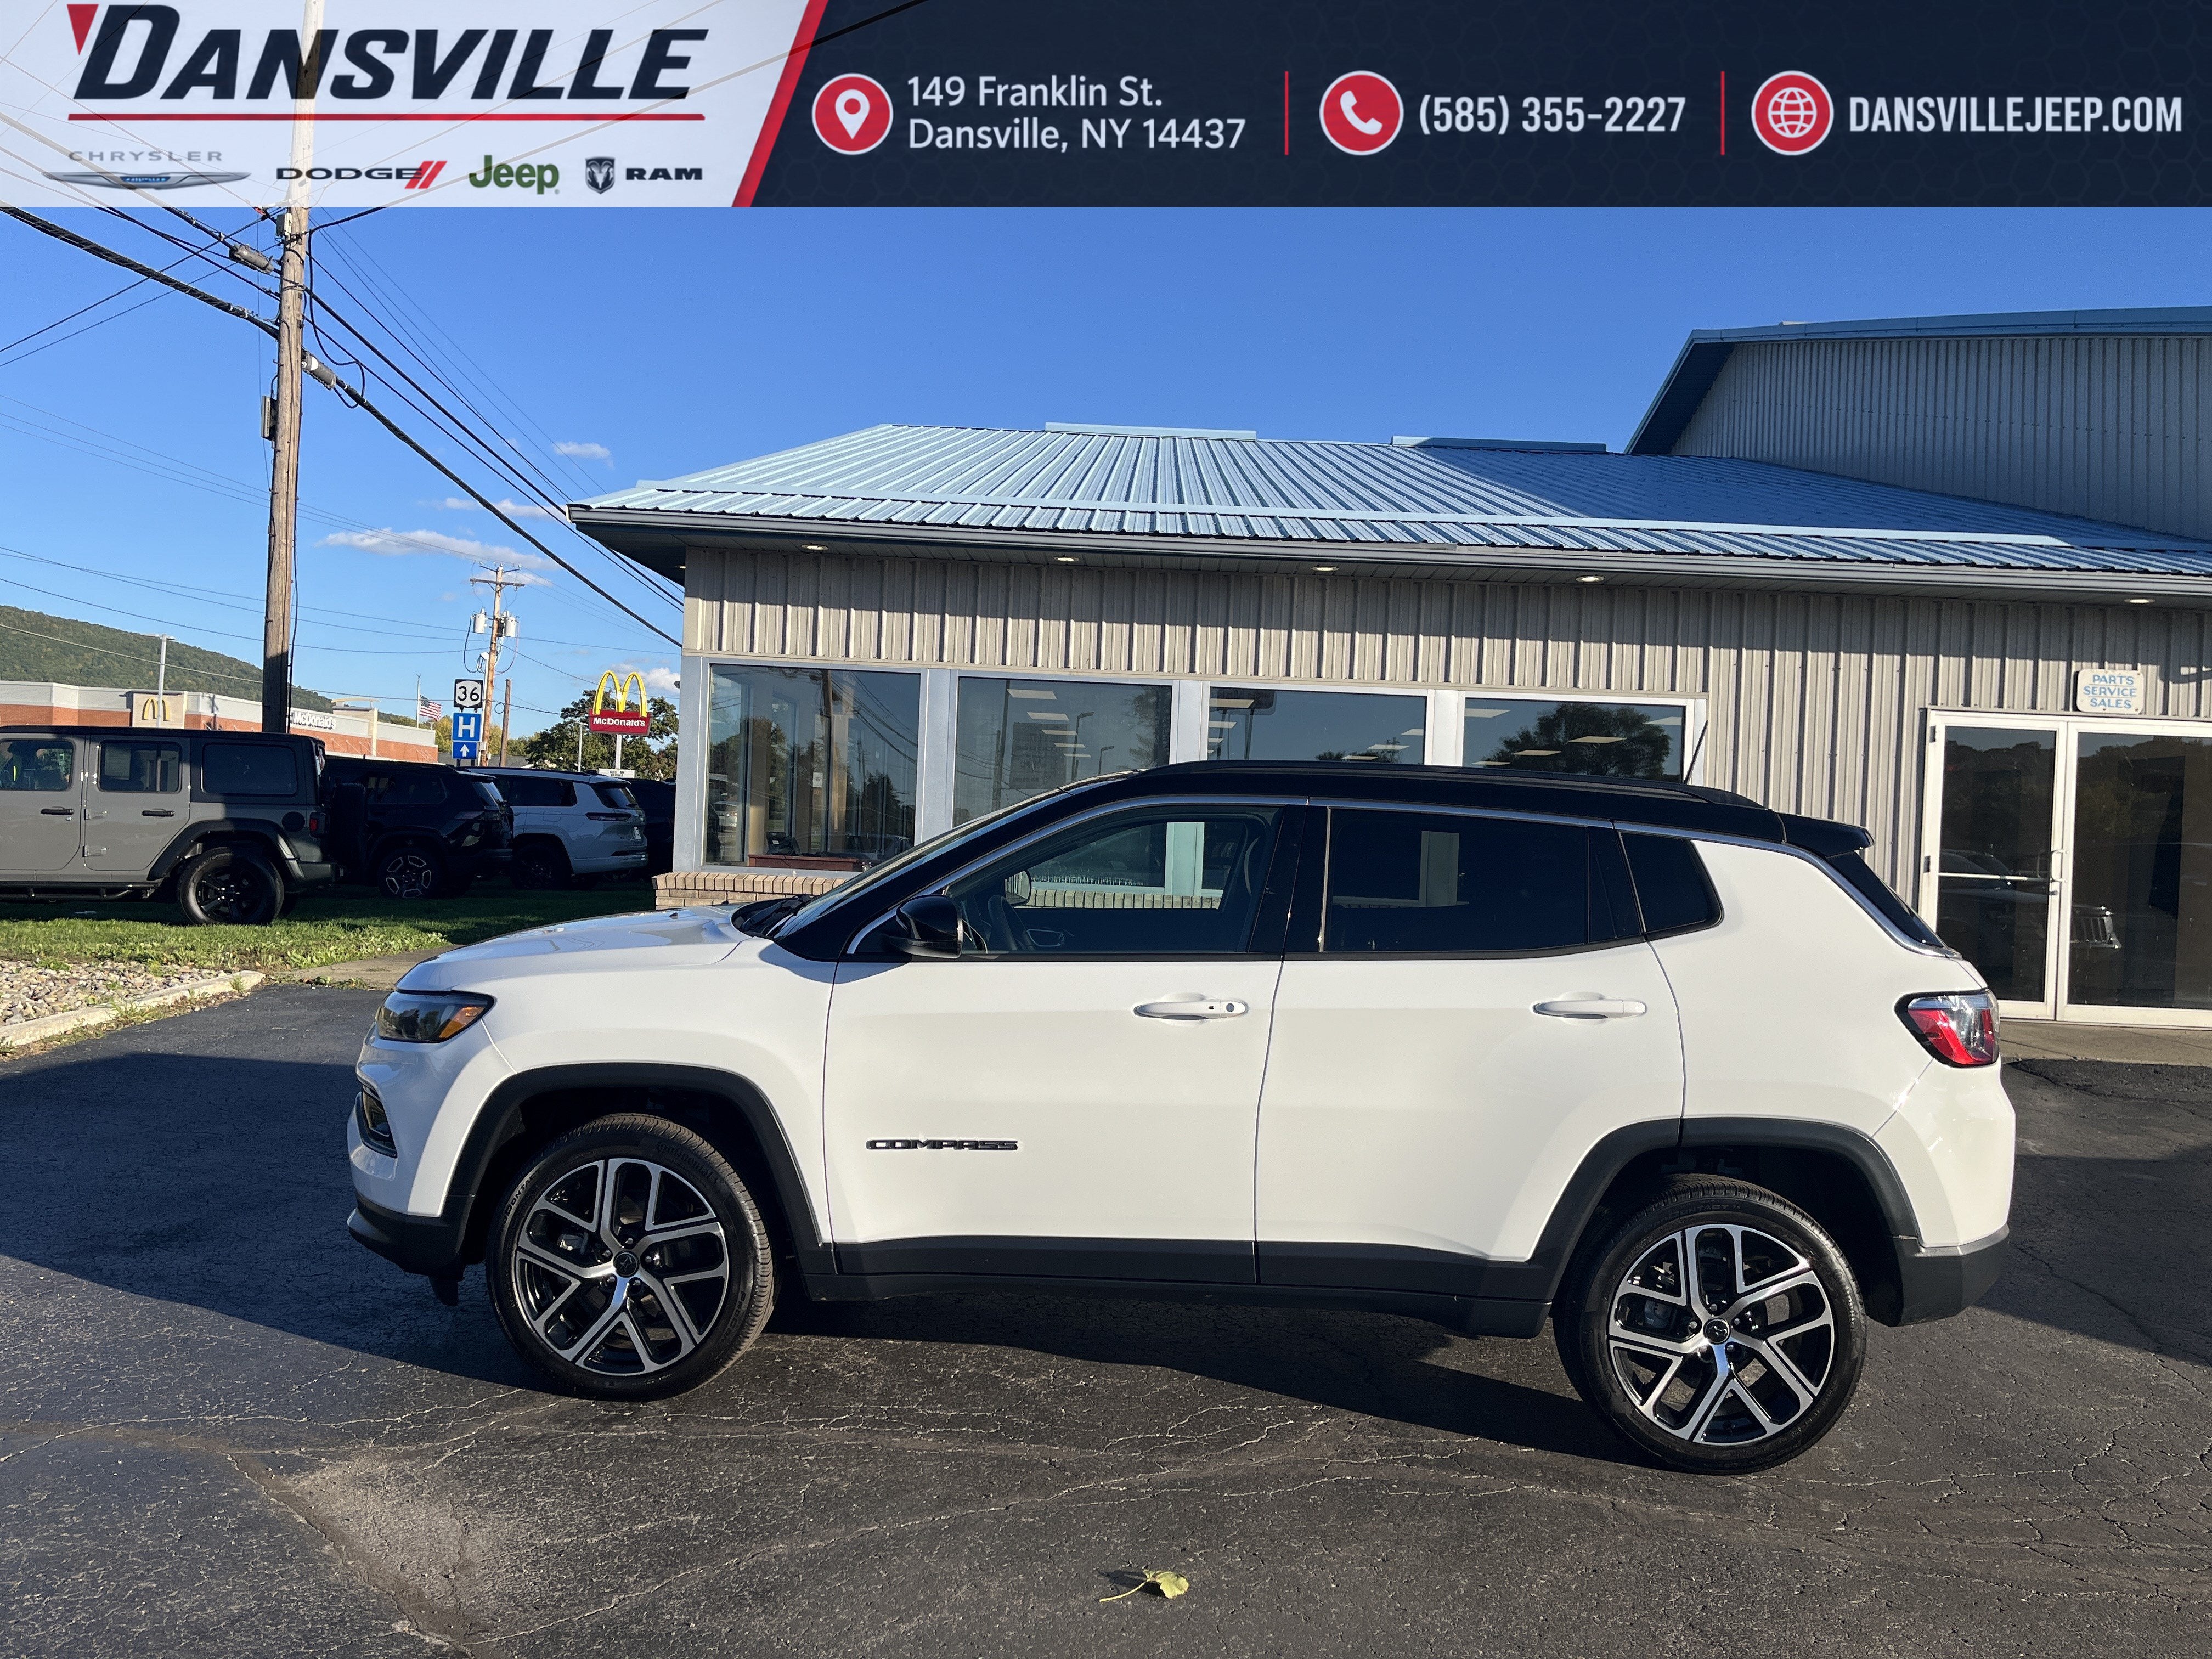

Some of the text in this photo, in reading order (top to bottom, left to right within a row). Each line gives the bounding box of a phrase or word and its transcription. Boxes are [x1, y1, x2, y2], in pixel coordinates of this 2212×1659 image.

[2092, 674, 2134, 685] PARTS
[457, 685, 479, 702] 36
[2083, 686, 2137, 697] SERVICE
[2089, 698, 2132, 709] SALES
[294, 711, 336, 729] McDonald's
[593, 717, 646, 727] McDonald's
[458, 716, 476, 738] H
[866, 1139, 1019, 1150] COMPASS
